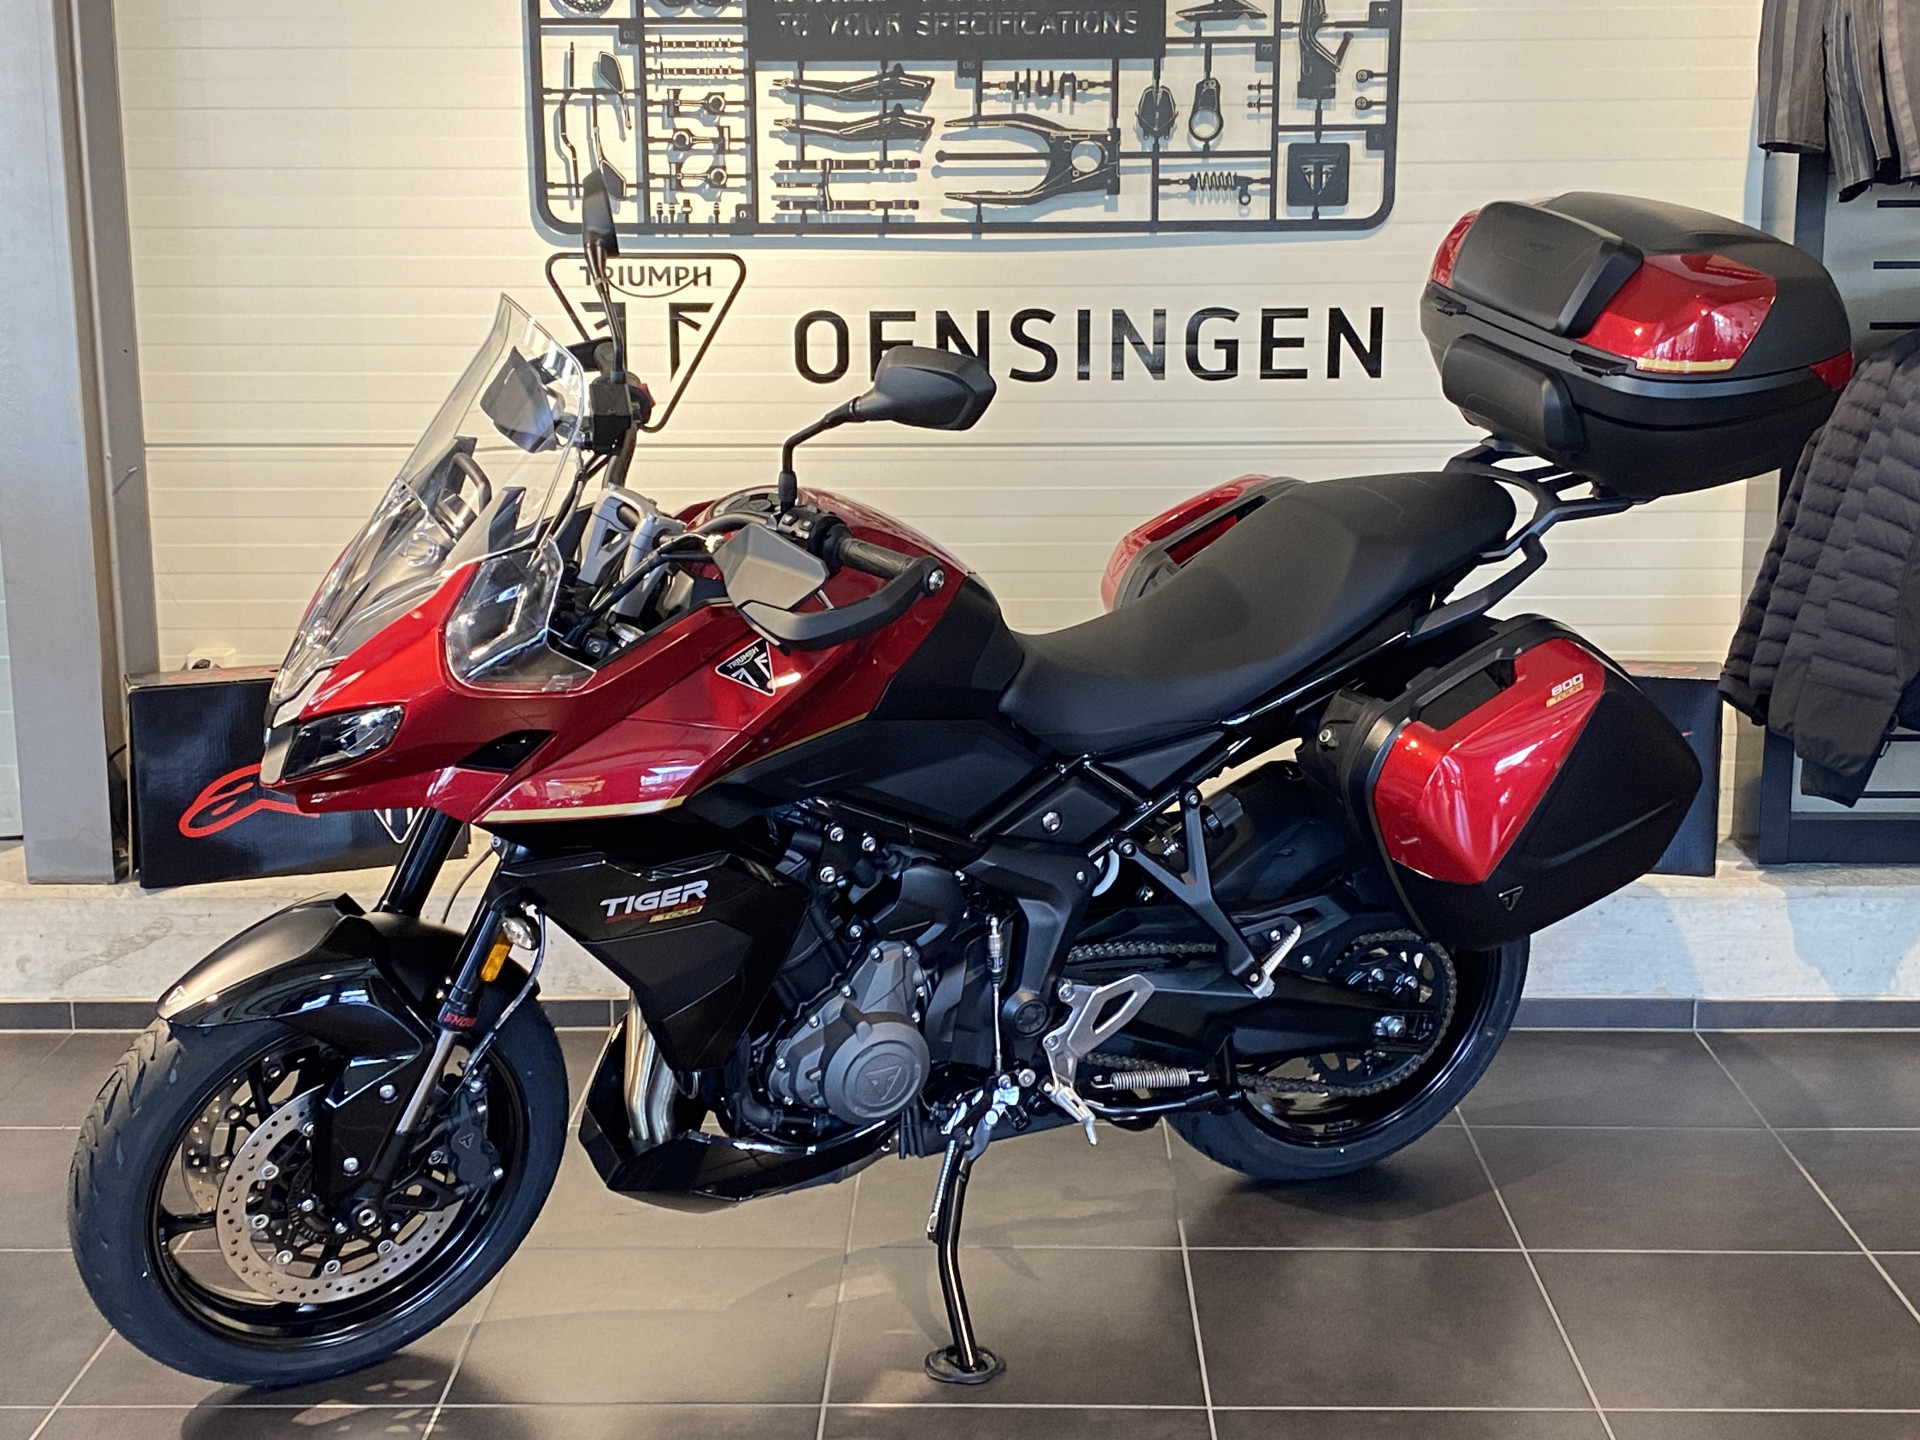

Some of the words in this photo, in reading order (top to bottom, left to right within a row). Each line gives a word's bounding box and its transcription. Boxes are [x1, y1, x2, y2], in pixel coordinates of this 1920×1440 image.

[775, 12, 808, 37] TO
[823, 12, 902, 37] YOUR
[916, 11, 1138, 36] SPECIFICATIONS
[793, 306, 1385, 383] OENSINGEN
[726, 646, 760, 670] TRIUMPH
[1551, 673, 1583, 696] 800
[600, 880, 709, 917] TIGER
